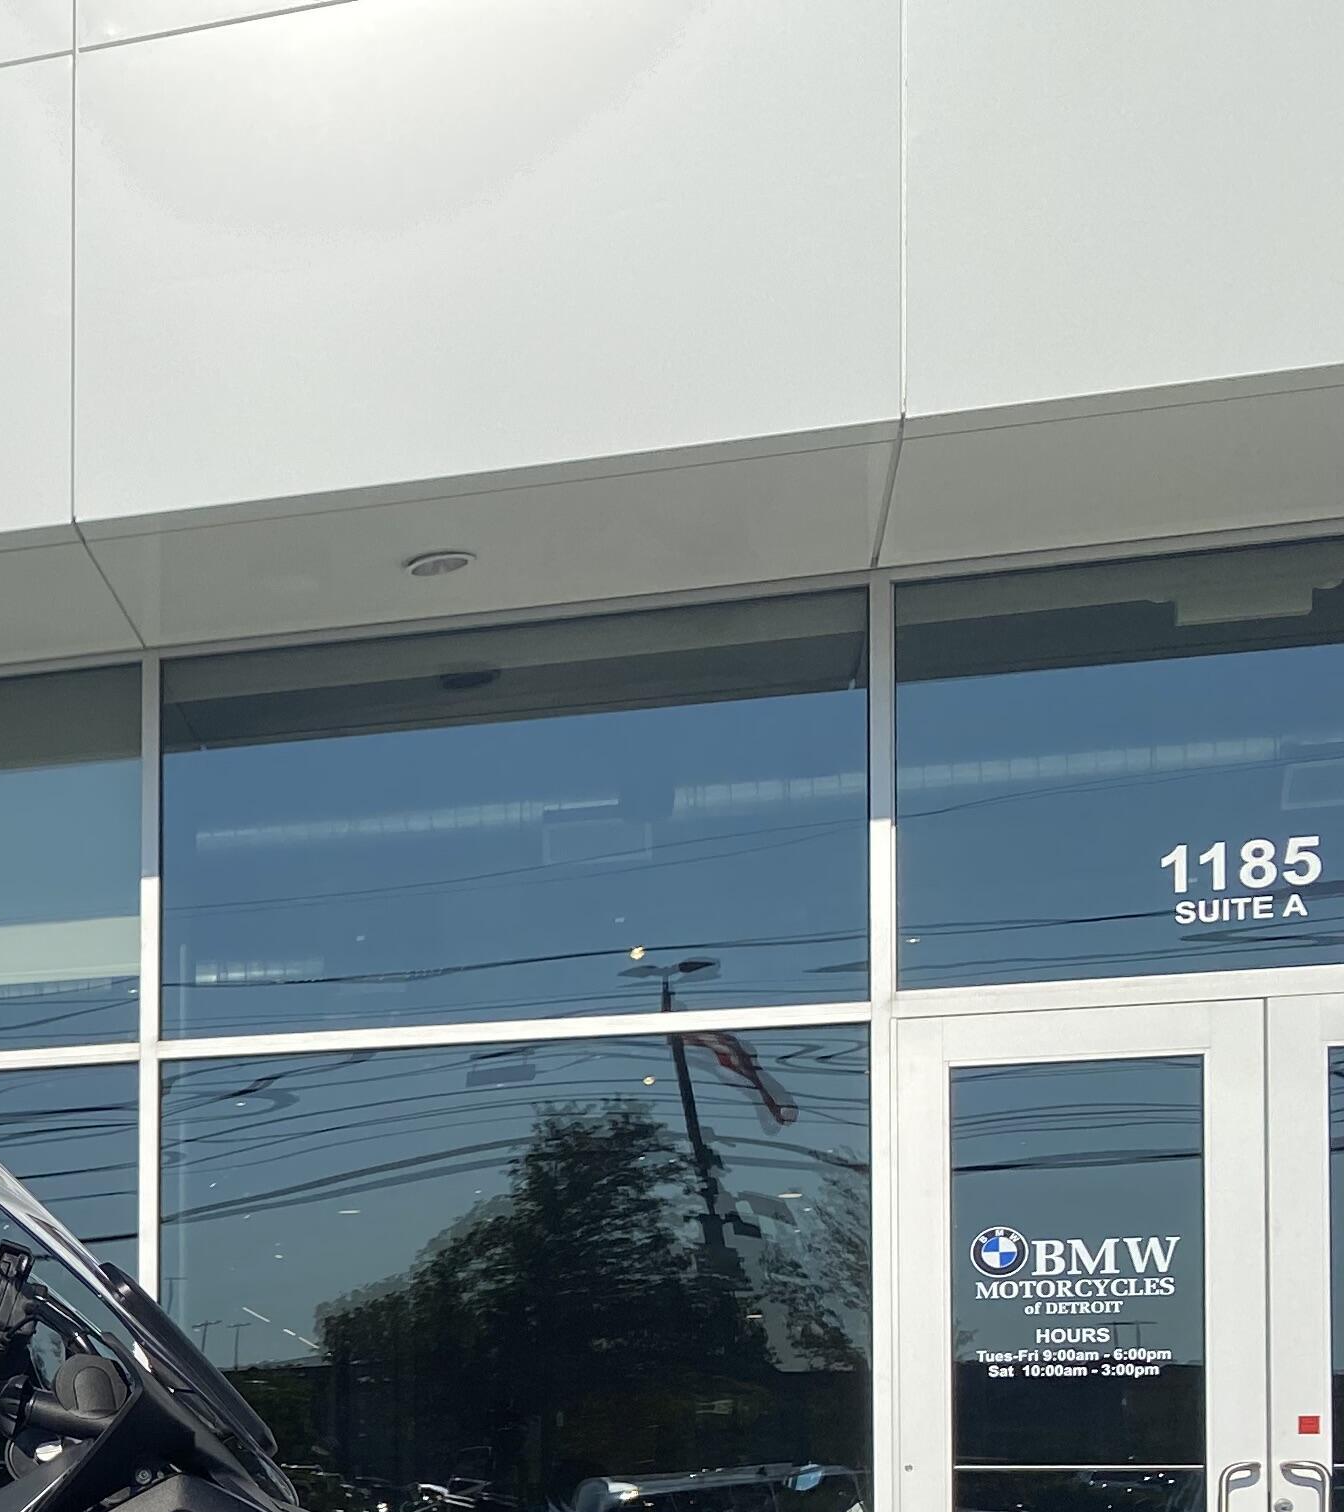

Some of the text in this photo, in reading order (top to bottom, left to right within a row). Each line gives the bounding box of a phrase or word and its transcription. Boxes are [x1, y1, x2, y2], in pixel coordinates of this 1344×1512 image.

[1160, 835, 1322, 893] 1185
[1175, 893, 1308, 925] SUITE A
[1031, 1236, 1181, 1276] BMW
[975, 1277, 1175, 1300] MOTORCYCLES
[1024, 1300, 1123, 1315] of DETROIT
[1036, 1328, 1110, 1344] HOURS
[976, 1349, 1039, 1362] Tues-Fri
[1042, 1350, 1099, 1362] 9:00am
[1113, 1349, 1172, 1363] 6:00pm
[988, 1365, 1014, 1378] Sat
[1023, 1365, 1087, 1377] 10:00am
[1101, 1364, 1160, 1378] 3:00pm
